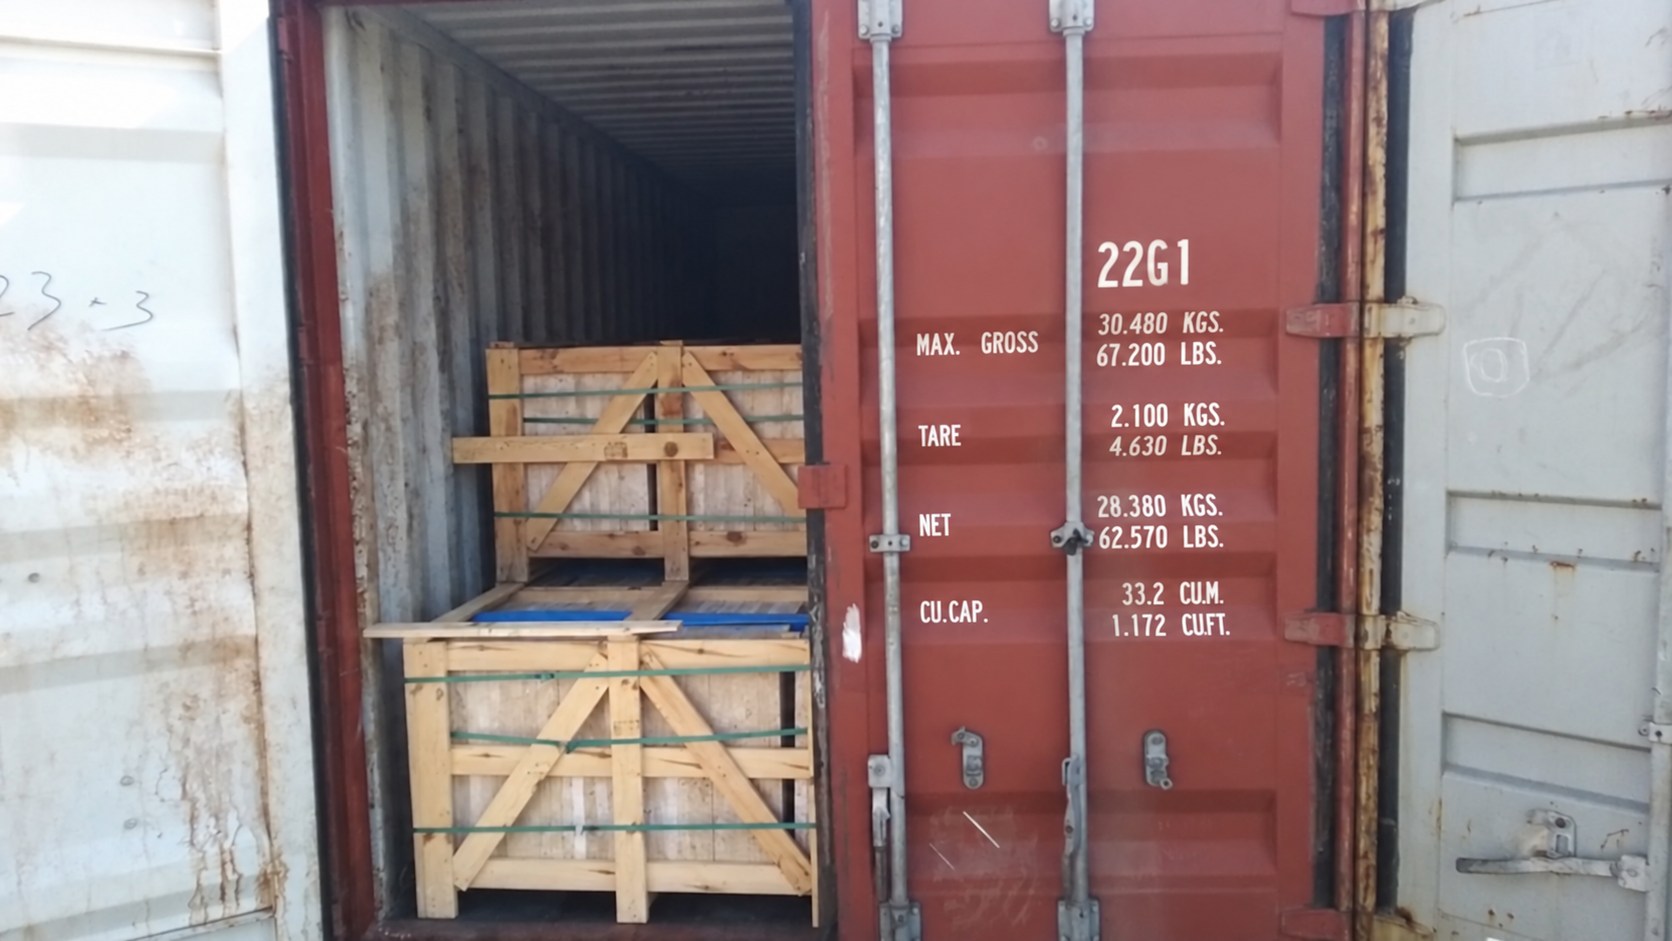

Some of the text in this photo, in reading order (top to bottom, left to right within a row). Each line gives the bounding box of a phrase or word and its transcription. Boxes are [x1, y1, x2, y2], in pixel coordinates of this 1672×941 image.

[1097, 238, 1190, 289] 22G1
[1097, 310, 1224, 336] 30.480 KGS.
[916, 330, 1039, 357] MAX. GROSS
[1096, 340, 1222, 367] 67.200 LBS.
[1110, 401, 1226, 428] 2.100 KGS.
[917, 424, 962, 448] TARE
[1108, 433, 1222, 457] 4.630 LBS.
[1096, 492, 1224, 518] 28.380 KGS.
[918, 512, 952, 537] NET
[1098, 524, 1225, 550] 62.570 LBS.
[1121, 580, 1225, 606] 33.2 CU.M.
[919, 600, 989, 624] CU.CAP.
[1111, 613, 1167, 638] 1.172
